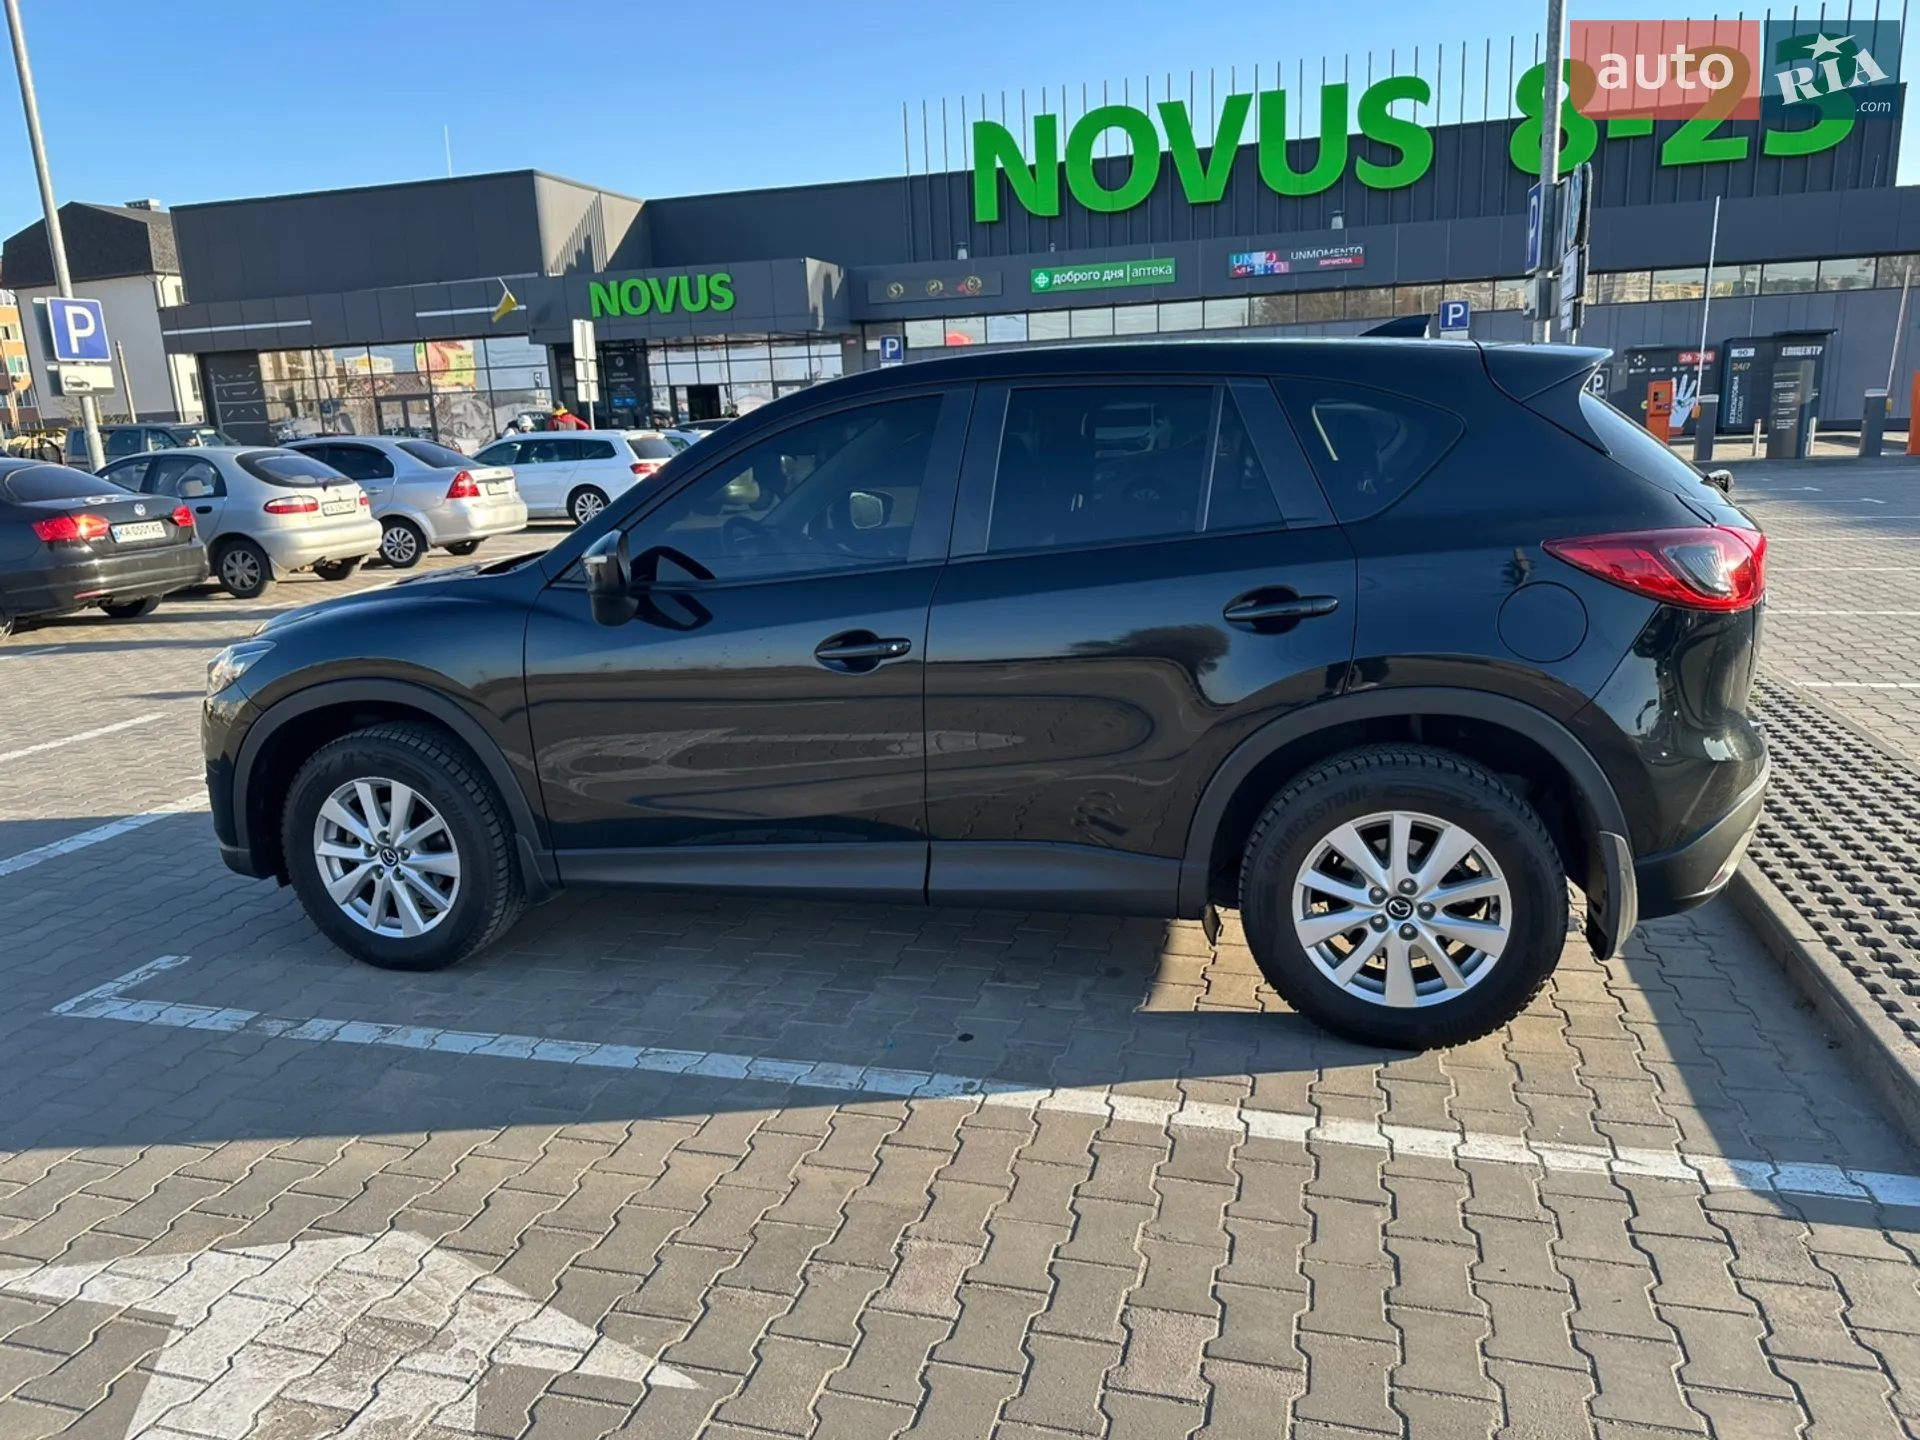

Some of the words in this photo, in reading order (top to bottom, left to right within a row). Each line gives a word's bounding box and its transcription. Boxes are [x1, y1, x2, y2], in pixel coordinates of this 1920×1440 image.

[973, 76, 1434, 222] NOVUS
[1528, 195, 1538, 262] P
[1052, 270, 1100, 285] доброго
[1103, 268, 1124, 282] дня
[1131, 264, 1172, 278] аптека
[589, 273, 735, 318] NOVUS
[64, 305, 96, 354] P
[1448, 303, 1464, 326] P
[885, 338, 899, 358] P
[1593, 374, 1604, 394] P
